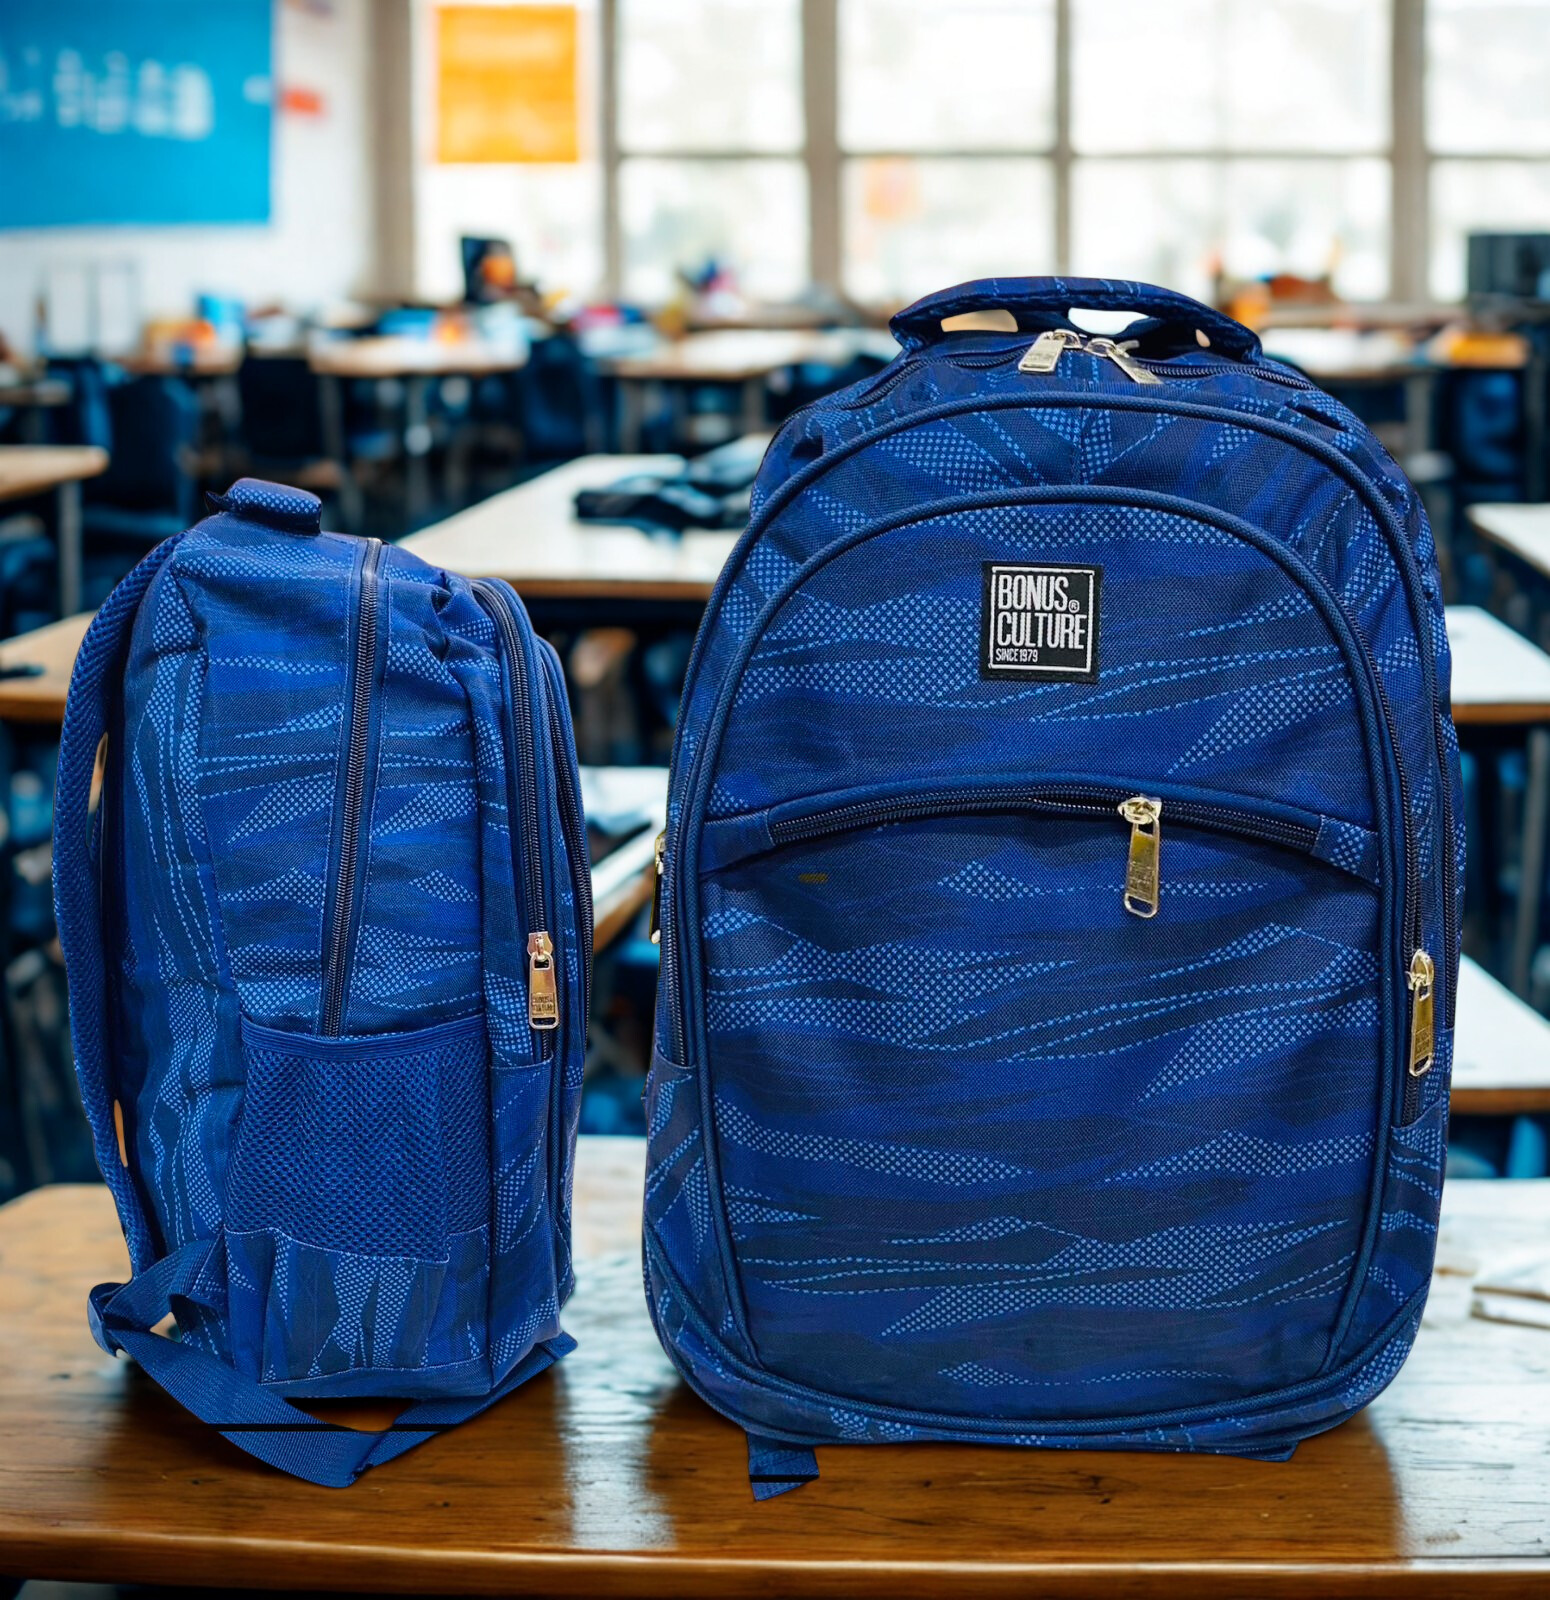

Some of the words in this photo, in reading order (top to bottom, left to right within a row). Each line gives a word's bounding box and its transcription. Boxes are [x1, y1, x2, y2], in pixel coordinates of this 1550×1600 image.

[997, 612, 1087, 649] CULTURE
[995, 648, 1019, 662] SINCE
[1019, 649, 1038, 663] 1979
